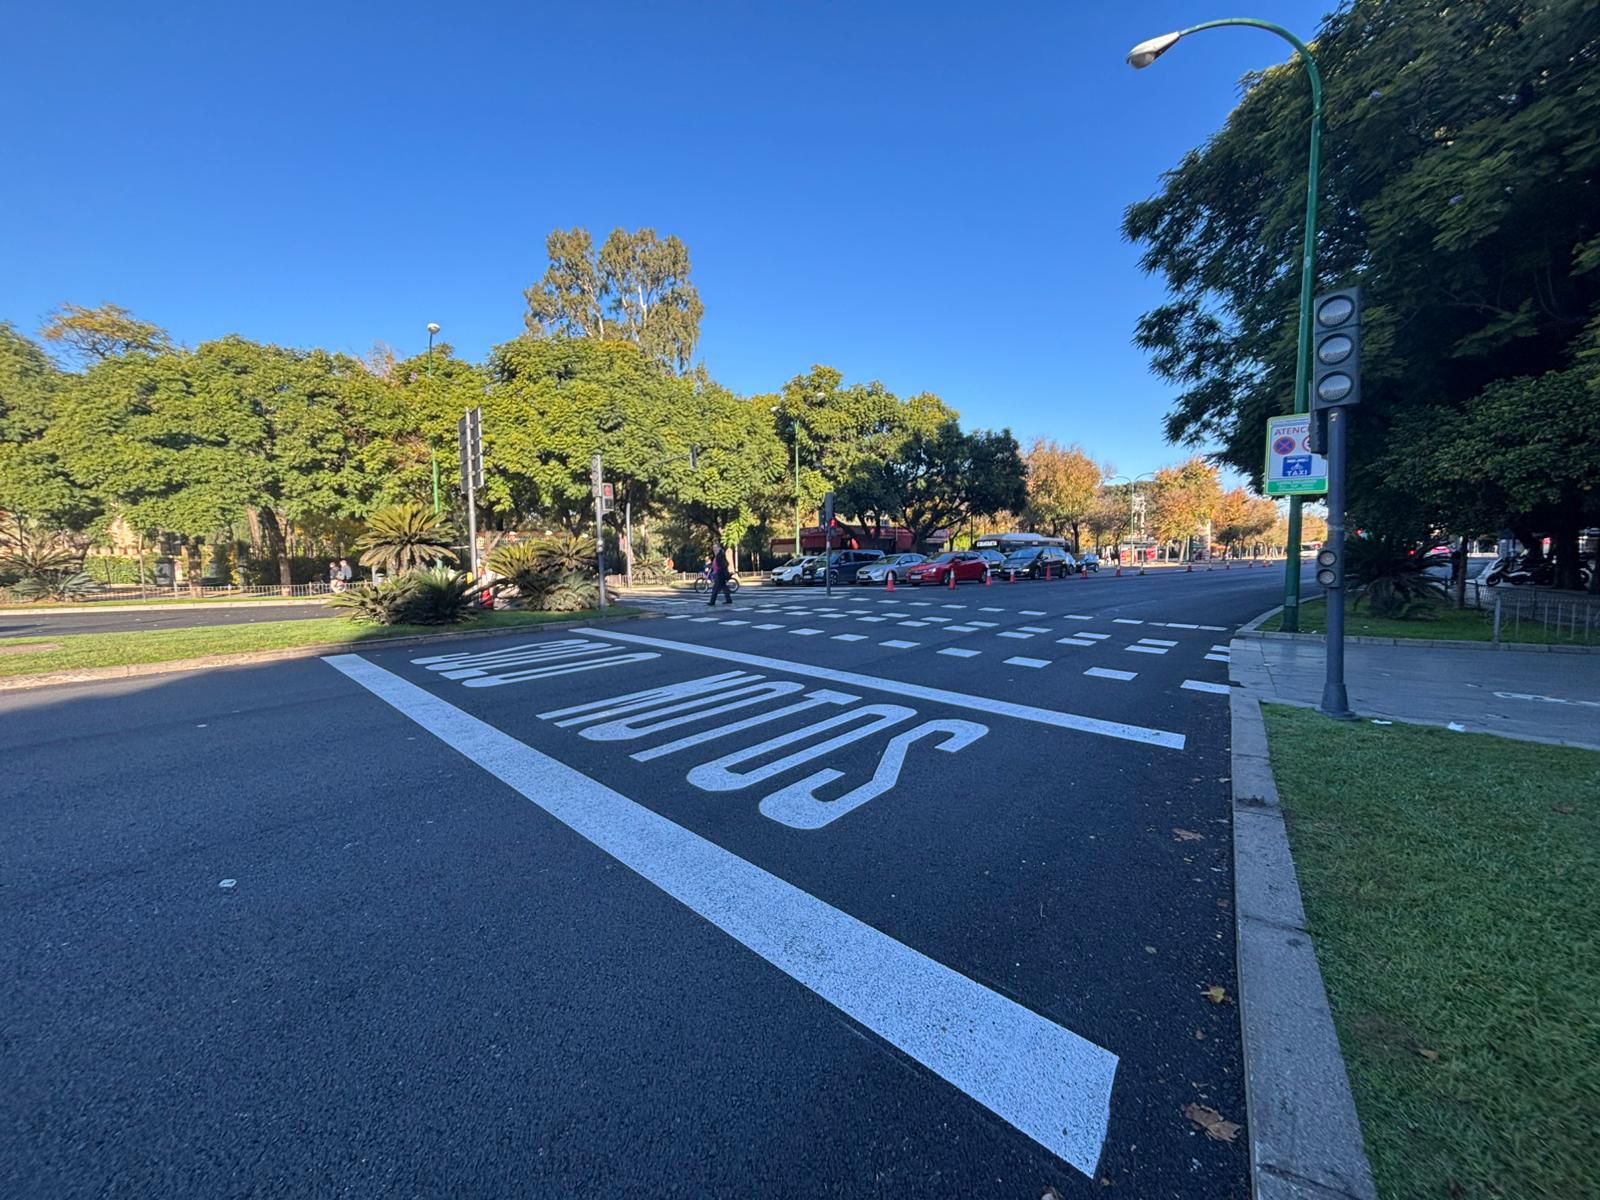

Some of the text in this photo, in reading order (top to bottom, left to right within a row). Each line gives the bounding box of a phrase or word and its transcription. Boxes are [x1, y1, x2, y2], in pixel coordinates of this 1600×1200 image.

[1274, 426, 1306, 436] ATENC
[409, 639, 990, 830] SOLO MOTOS
